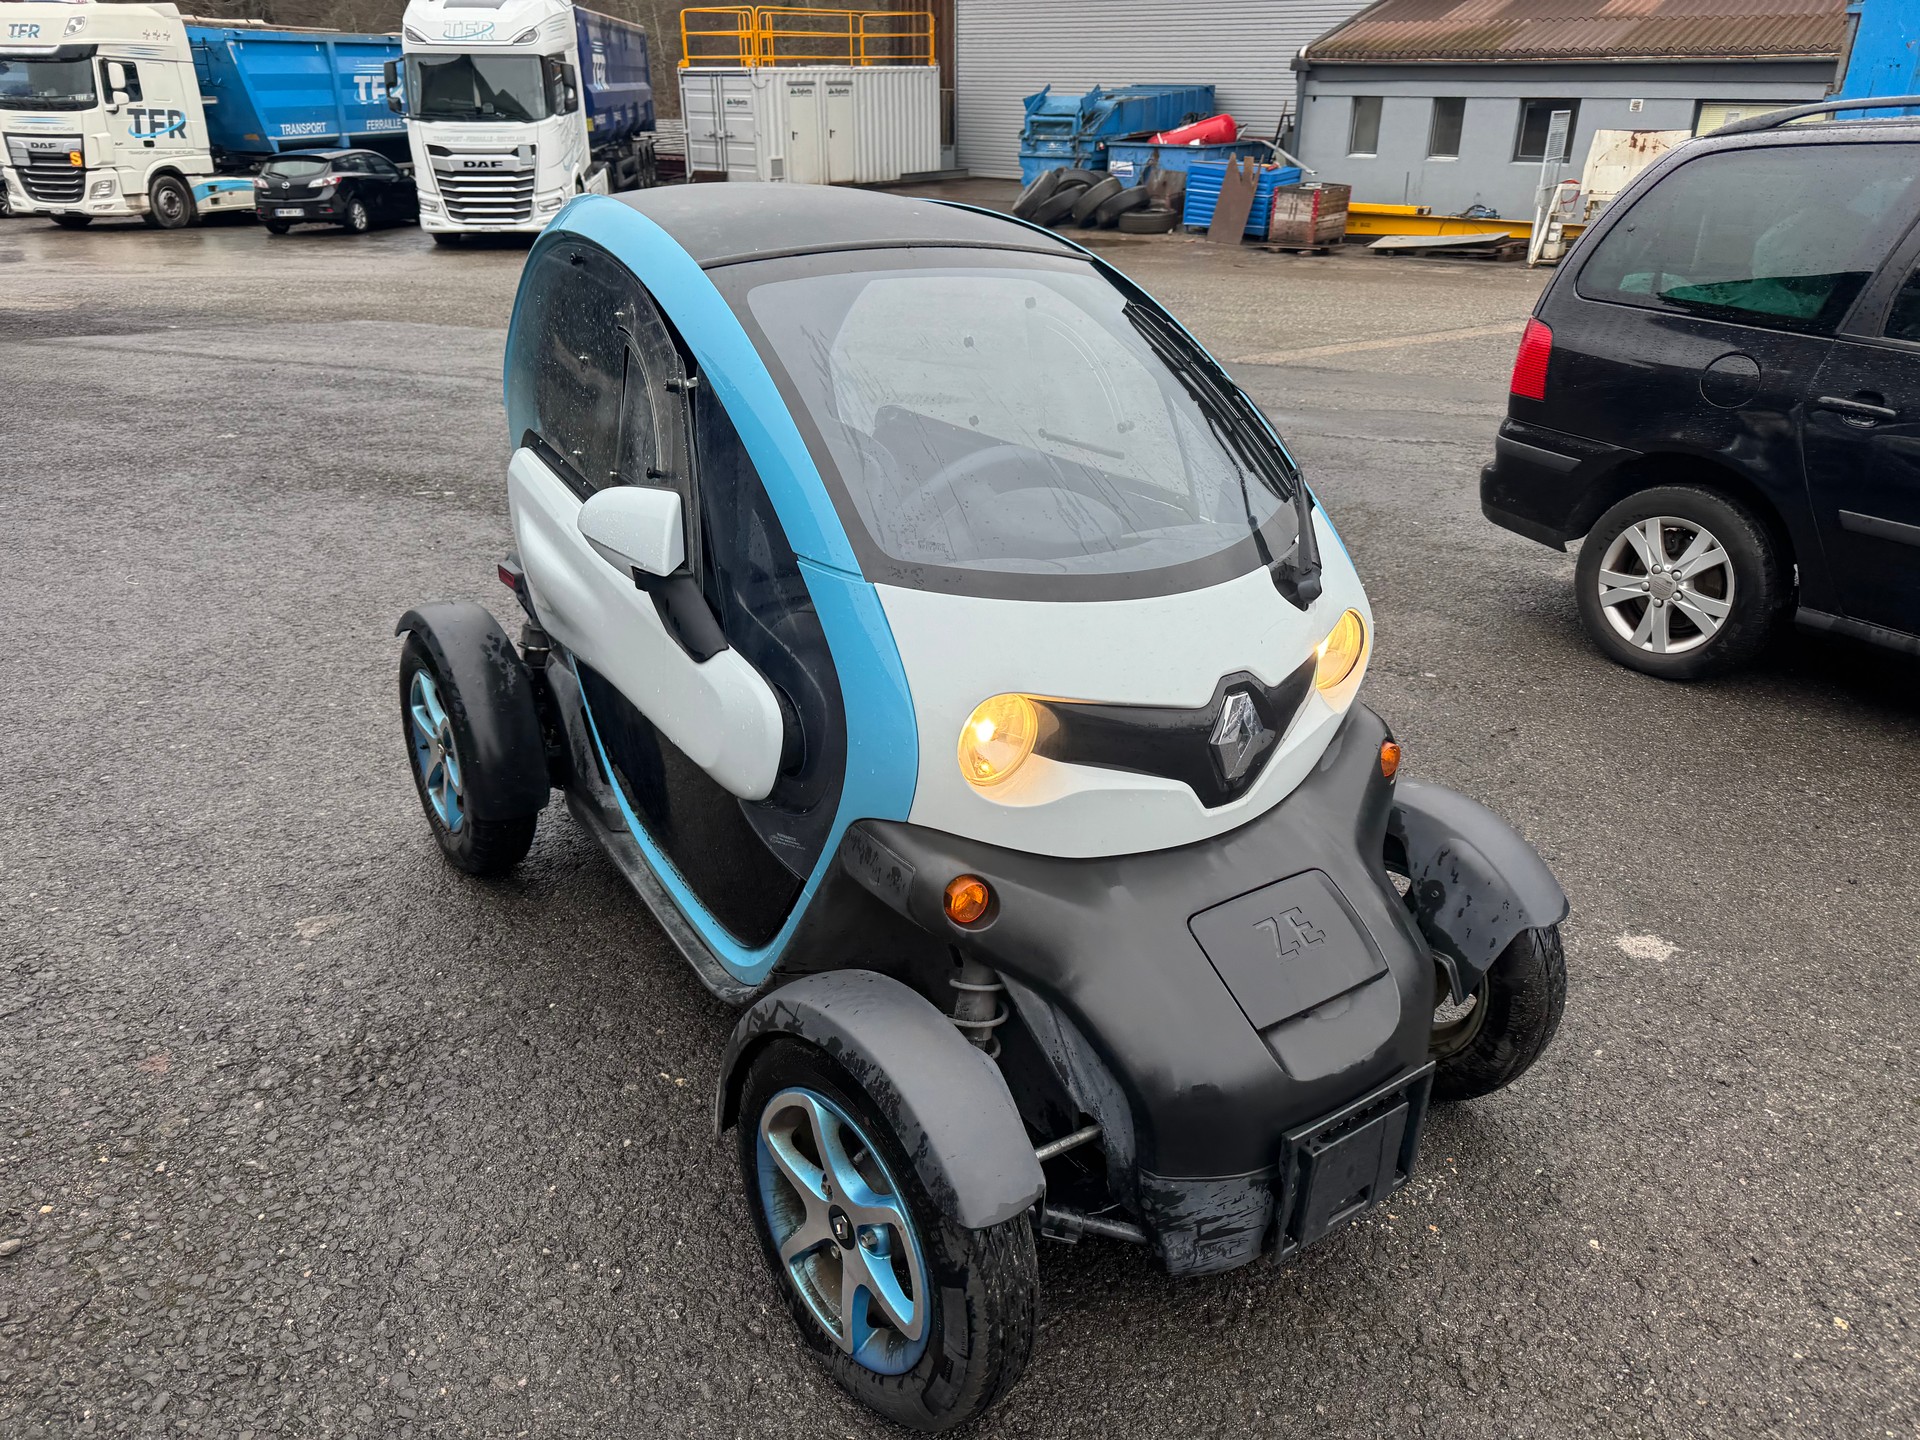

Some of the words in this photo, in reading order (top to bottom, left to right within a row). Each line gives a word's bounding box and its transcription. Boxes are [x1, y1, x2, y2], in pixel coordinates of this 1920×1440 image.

[8, 23, 40, 39] TFR
[444, 20, 496, 40] TFR
[127, 108, 187, 139] TFR
[280, 122, 326, 136] TRANSPORT
[366, 118, 402, 131] FERRAILLE
[1252, 906, 1326, 965] ZE
